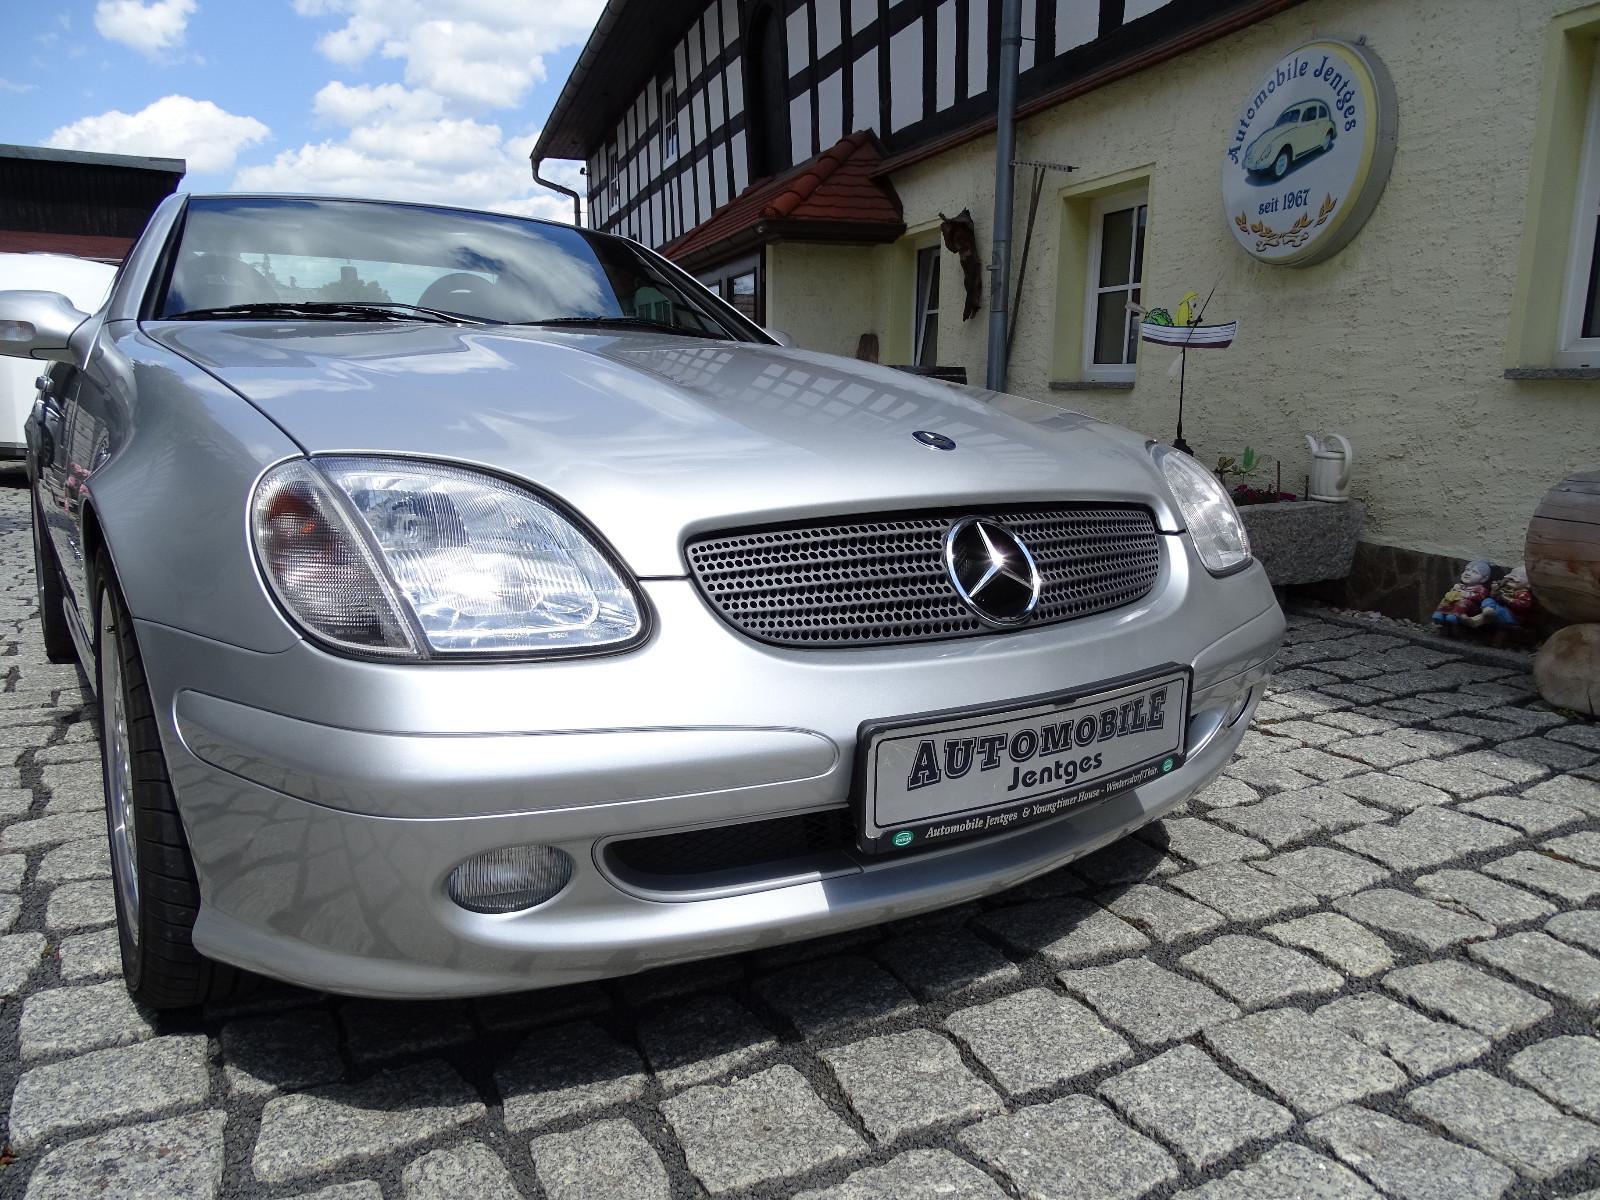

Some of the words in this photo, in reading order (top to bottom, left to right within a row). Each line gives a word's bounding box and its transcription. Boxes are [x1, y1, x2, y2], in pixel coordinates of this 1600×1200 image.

[1228, 57, 1309, 165] Automobile
[1313, 56, 1356, 132] Jentges
[1258, 196, 1279, 215] seit
[1282, 188, 1311, 209] 1967
[907, 686, 1168, 791] AUTOMOBILE
[1007, 752, 1103, 791] Jentges
[925, 817, 983, 838] Automobile
[984, 812, 1018, 829] Jentges
[1022, 807, 1030, 817] &
[1032, 797, 1077, 814] Youngtimer
[1078, 789, 1100, 802] House
